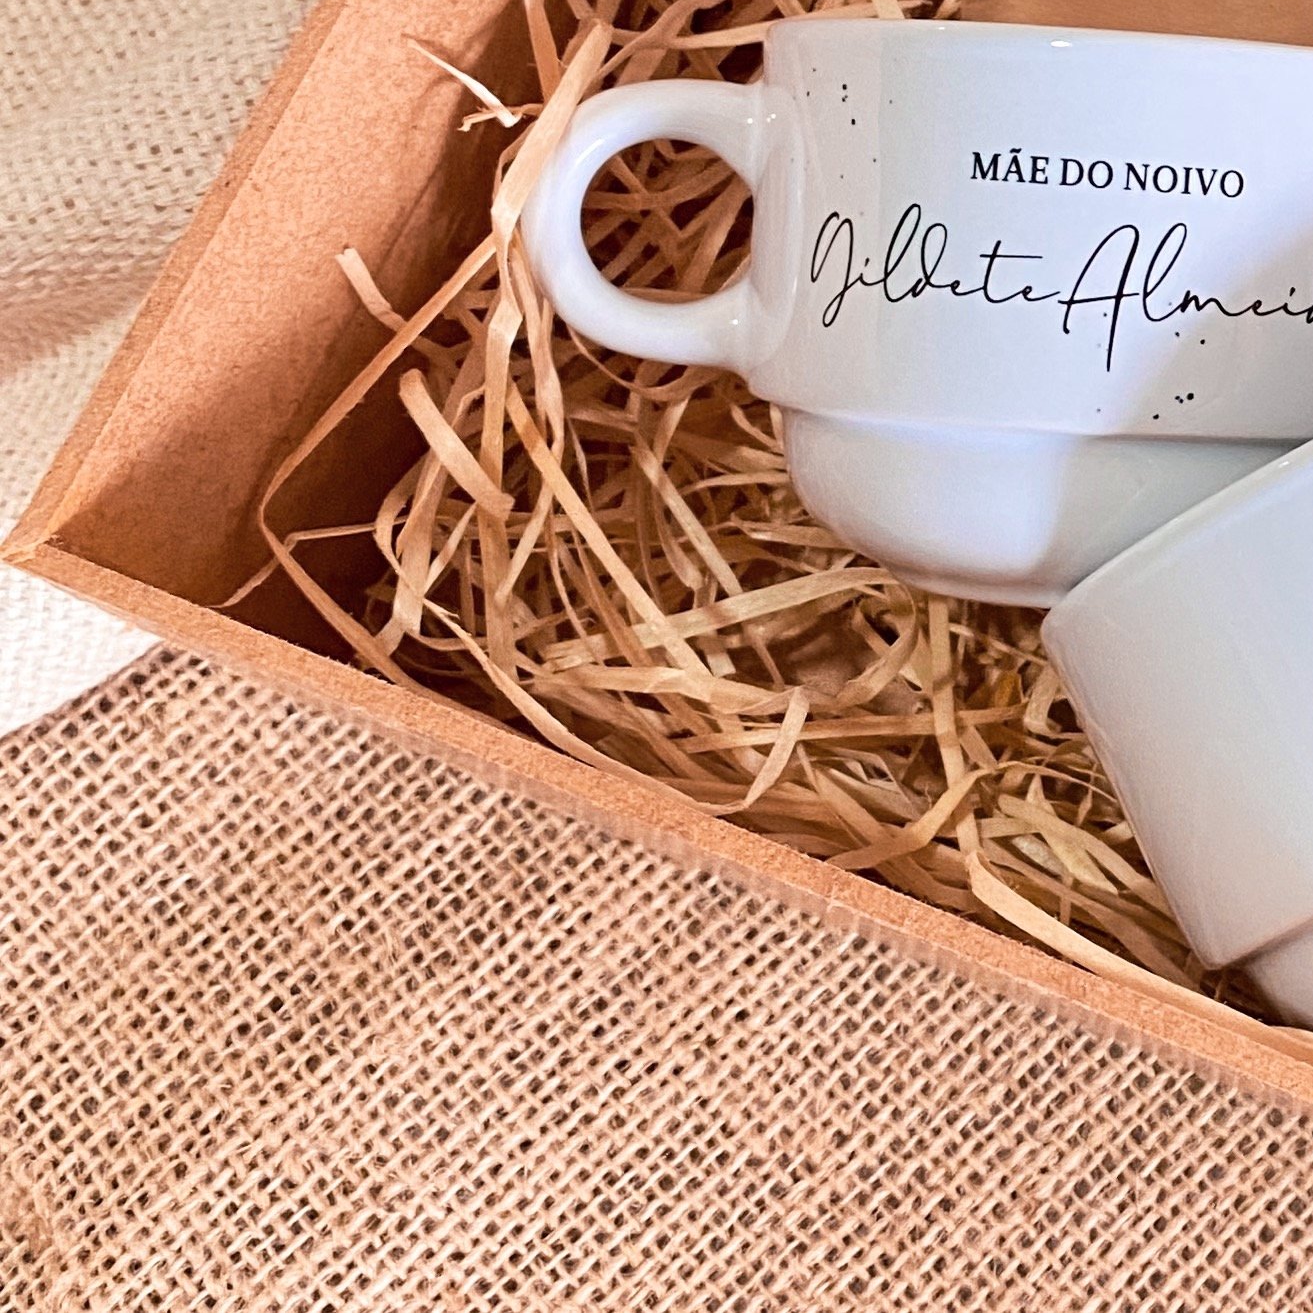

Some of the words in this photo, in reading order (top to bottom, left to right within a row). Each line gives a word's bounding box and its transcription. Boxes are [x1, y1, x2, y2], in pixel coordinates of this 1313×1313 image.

[969, 148, 1050, 185] MÃE
[1058, 157, 1114, 190] DO
[1124, 161, 1246, 199] NOIVO
[809, 202, 1062, 328] Gildete
